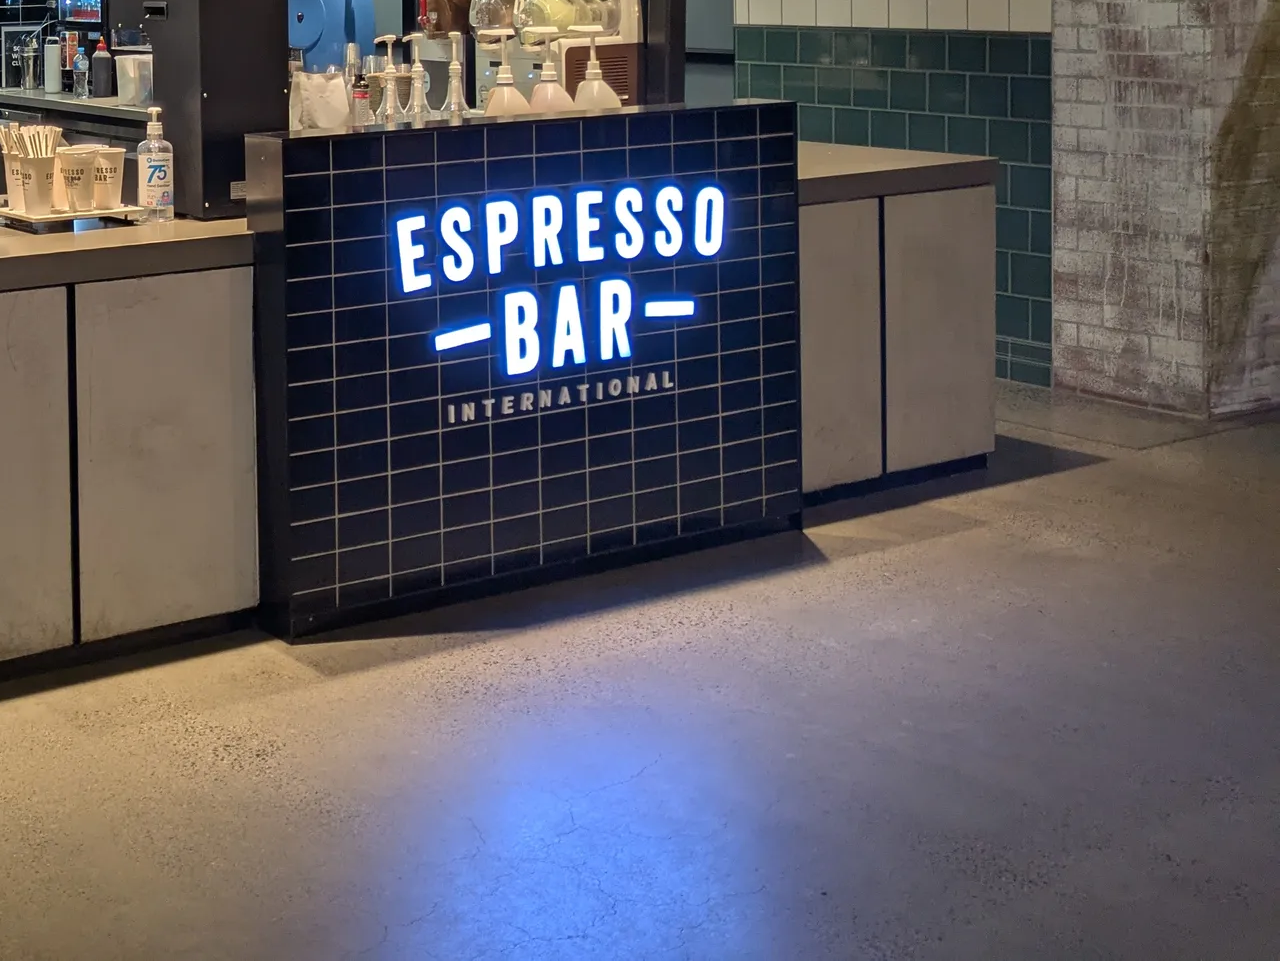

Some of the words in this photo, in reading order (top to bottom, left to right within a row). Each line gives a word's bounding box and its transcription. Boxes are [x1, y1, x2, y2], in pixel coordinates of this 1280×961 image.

[396, 186, 724, 293] ESPRESSO
[504, 279, 632, 376] BAR
[448, 370, 674, 424] INTERNATIONAL
